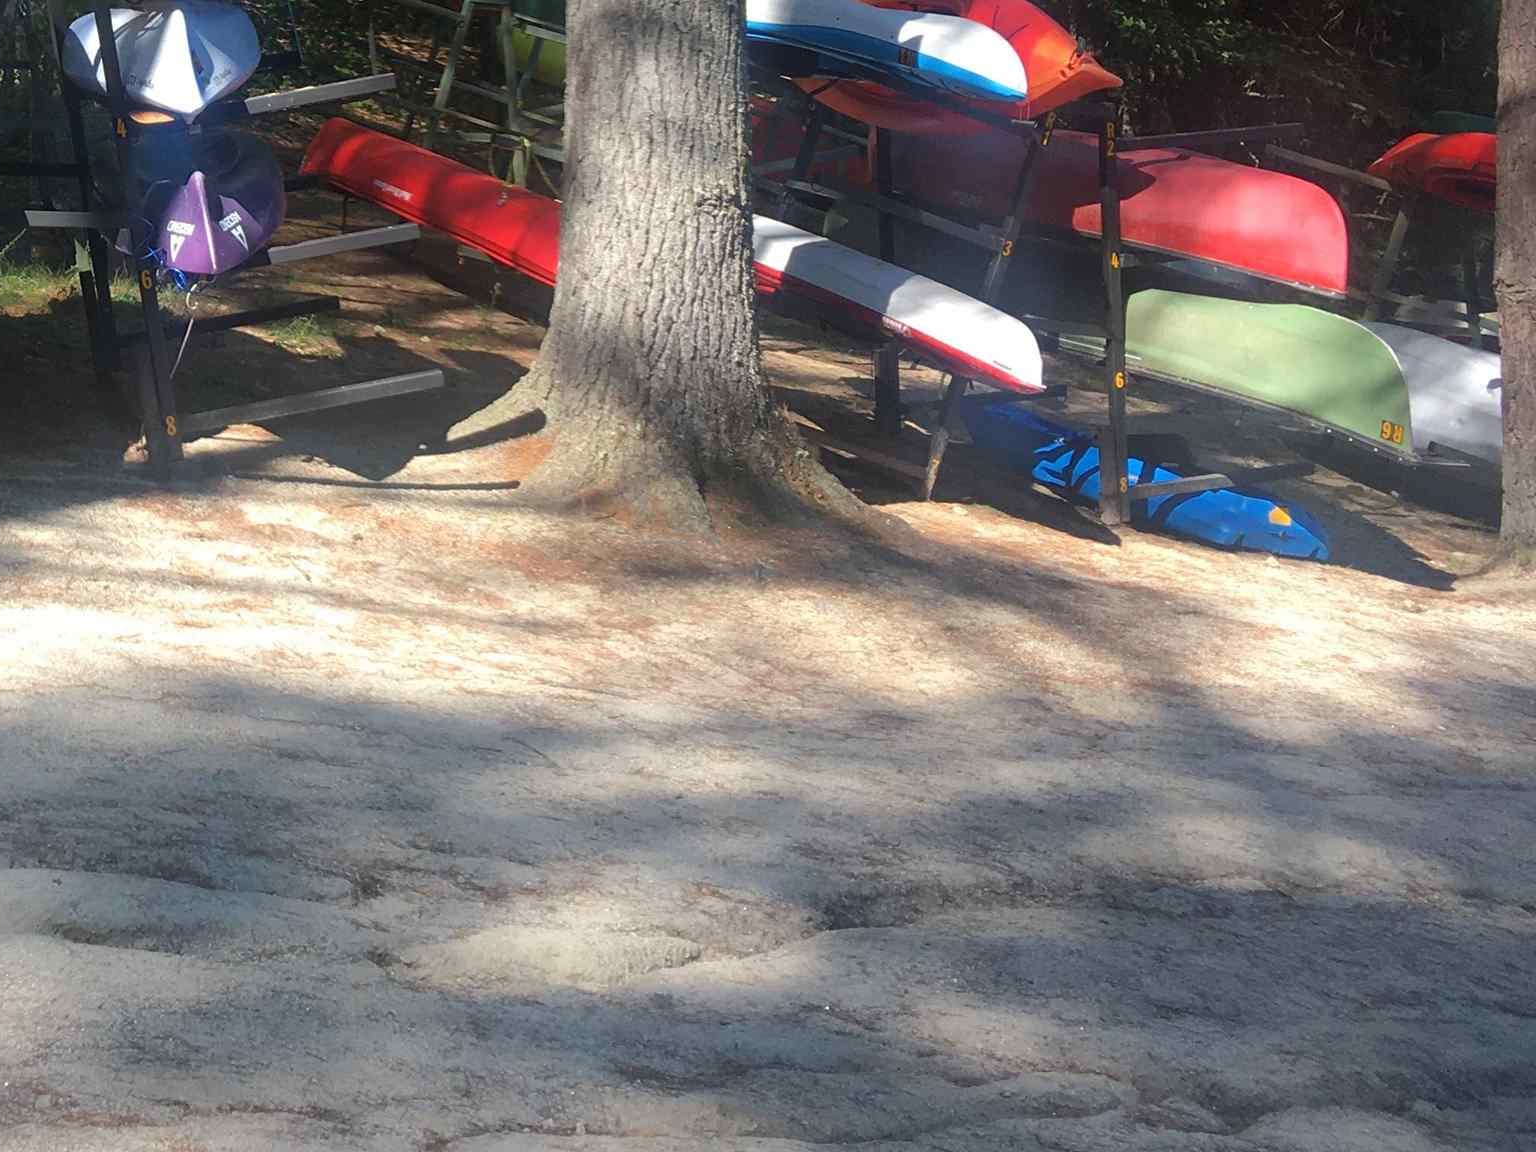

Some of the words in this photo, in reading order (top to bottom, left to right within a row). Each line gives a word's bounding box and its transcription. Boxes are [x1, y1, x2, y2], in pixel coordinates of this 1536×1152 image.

[1107, 140, 1115, 157] 2
[1002, 240, 1013, 257] 3
[141, 270, 153, 289] 6
[1116, 372, 1124, 388] 6
[166, 416, 176, 436] 8
[1120, 477, 1128, 493] 8
